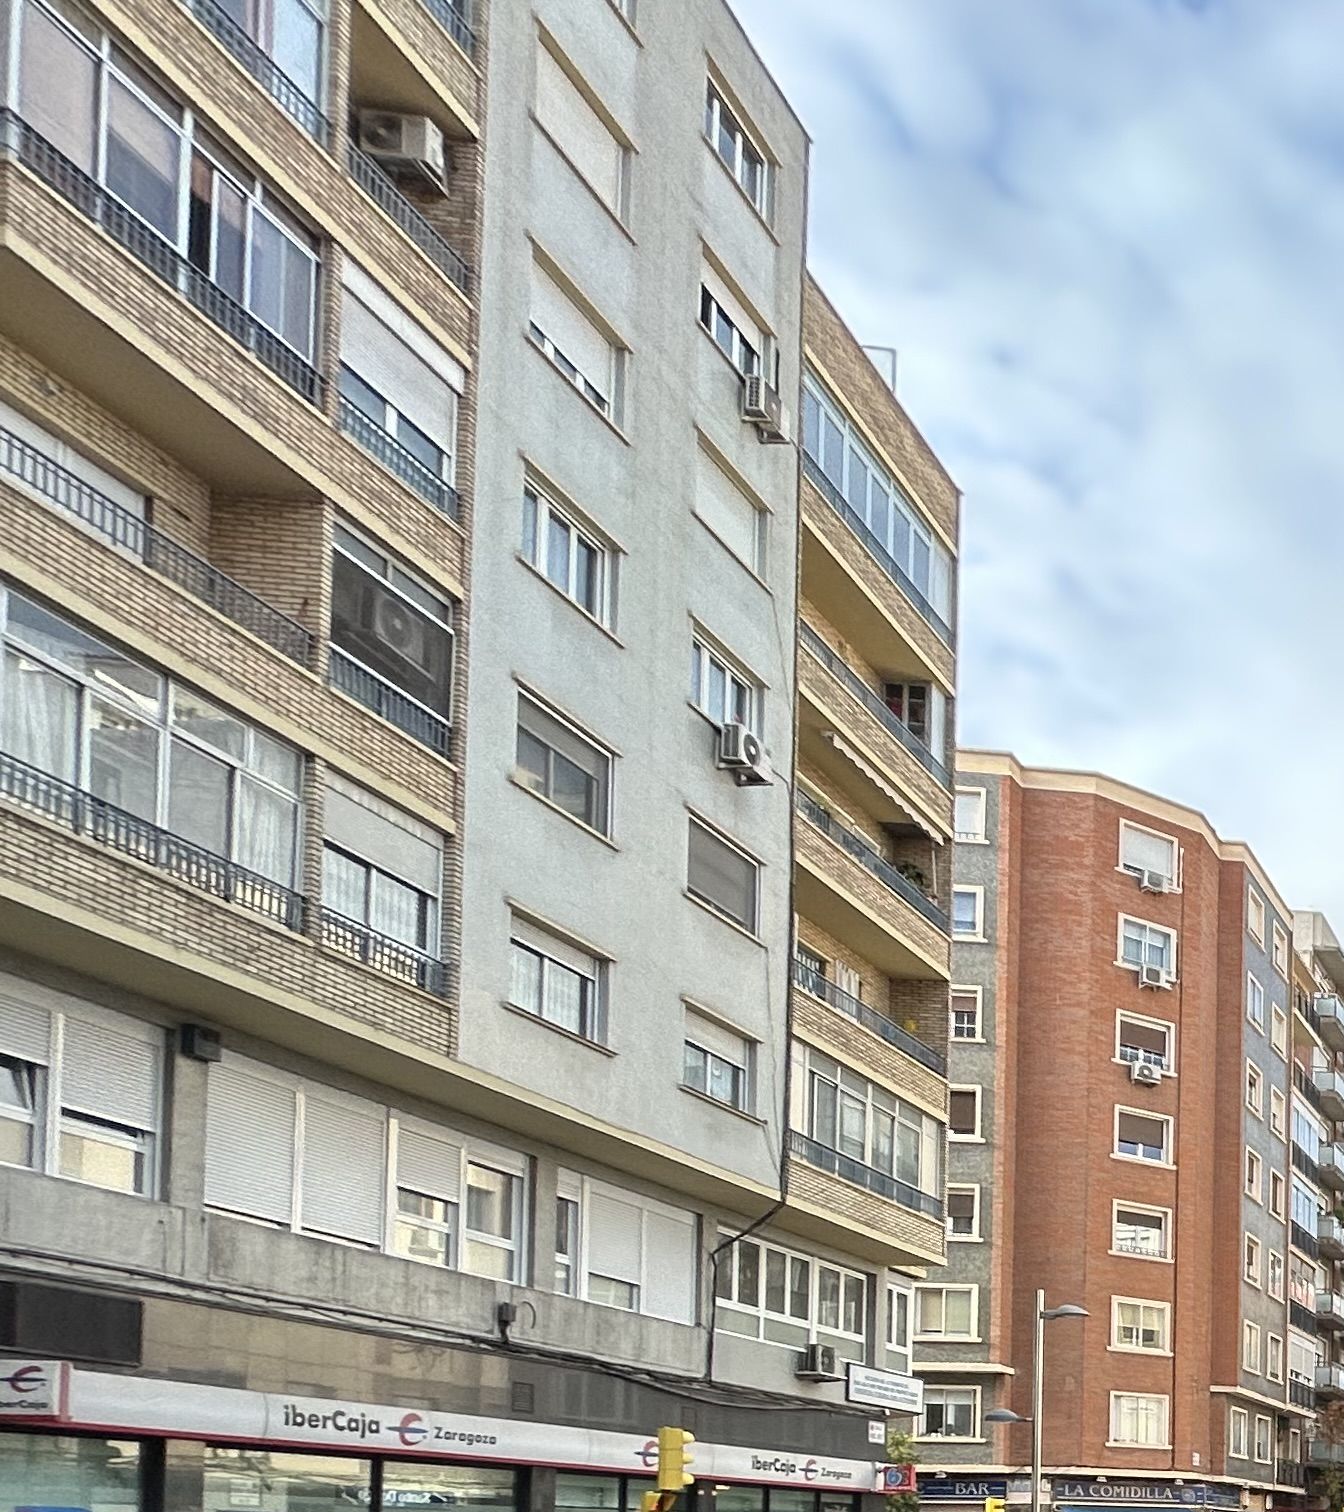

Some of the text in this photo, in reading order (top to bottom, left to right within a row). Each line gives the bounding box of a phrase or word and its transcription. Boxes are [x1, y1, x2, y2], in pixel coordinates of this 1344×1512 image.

[283, 1404, 497, 1446] iberCaja Zaragoza
[752, 1455, 796, 1477] iberCaja
[955, 1482, 990, 1495] BAR
[1065, 1484, 1173, 1499] LA COMIDILLA
